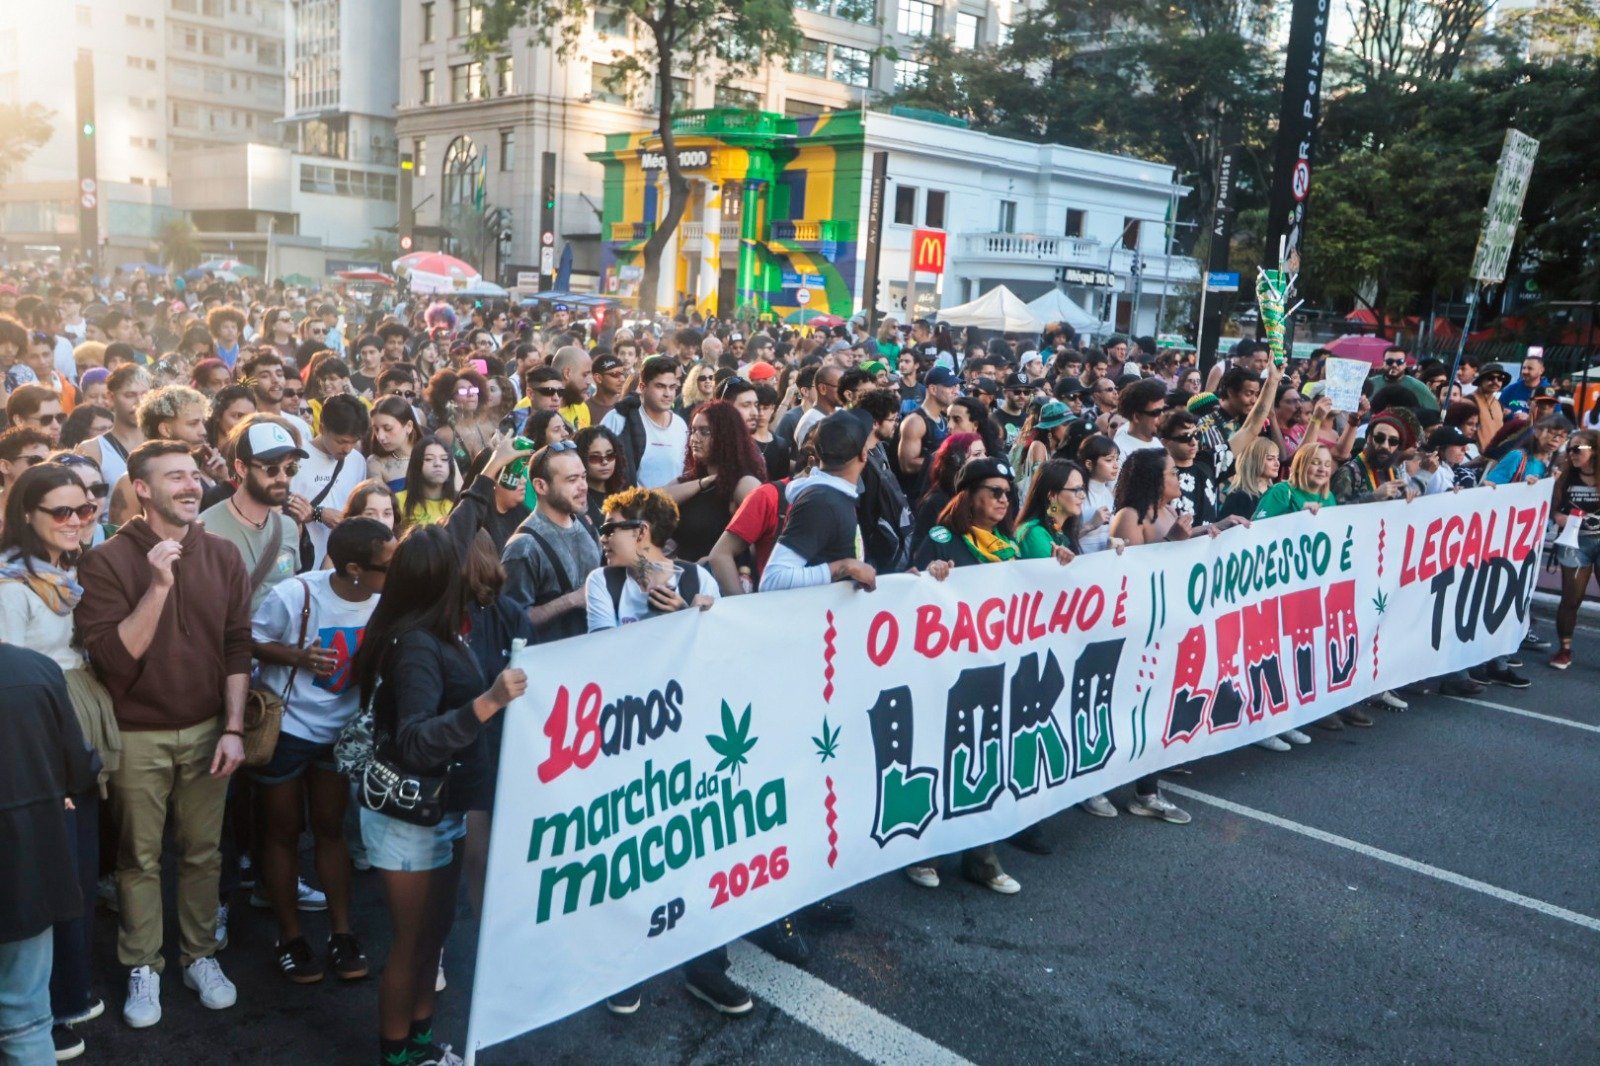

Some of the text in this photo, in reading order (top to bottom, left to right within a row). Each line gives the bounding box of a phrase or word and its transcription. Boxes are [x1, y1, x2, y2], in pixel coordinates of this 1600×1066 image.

[1300, 0, 1326, 159] R. Peixoto
[678, 151, 707, 167] 1000
[870, 178, 880, 221] Paulista
[1214, 155, 1231, 236] Av. Paulista
[867, 575, 1128, 667] O BAGULHO É
[1188, 525, 1353, 615] O PROCESSO É
[1431, 549, 1537, 651] TUDO
[1161, 579, 1359, 748] LENTO
[537, 679, 684, 784] 18 anos
[866, 637, 1126, 849] LOKO
[527, 759, 719, 862] marcha da
[536, 776, 787, 924] maconha
[647, 846, 790, 938] SP 2026
